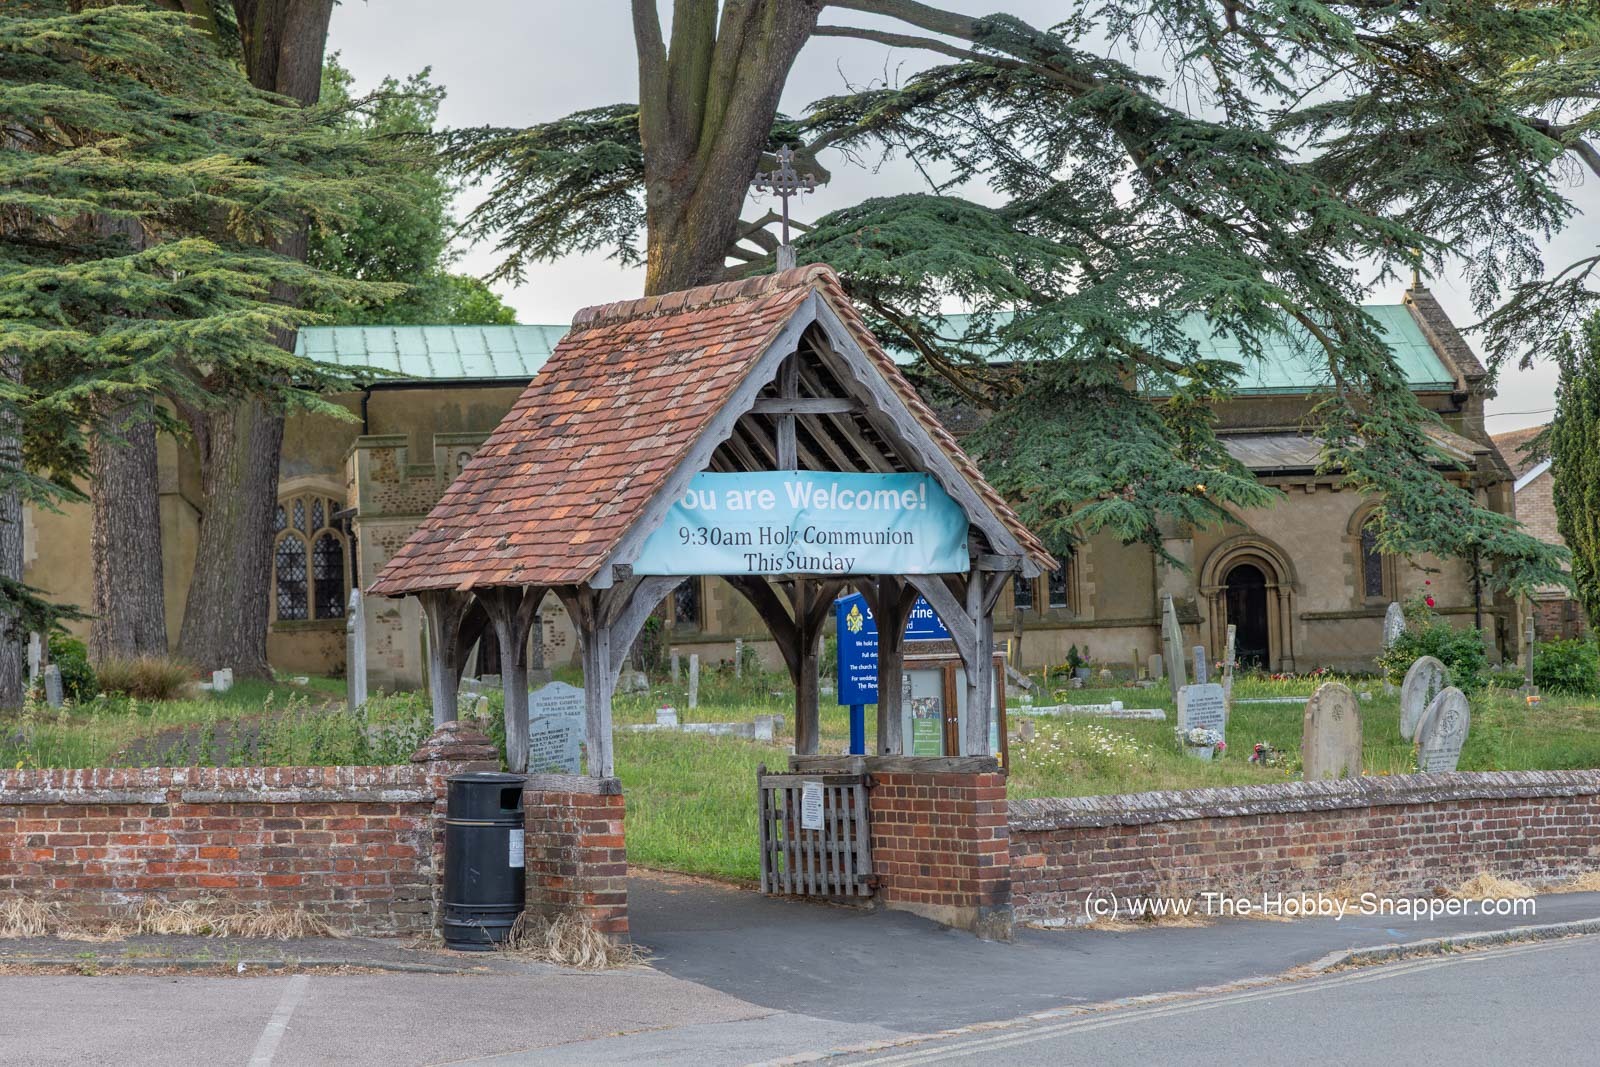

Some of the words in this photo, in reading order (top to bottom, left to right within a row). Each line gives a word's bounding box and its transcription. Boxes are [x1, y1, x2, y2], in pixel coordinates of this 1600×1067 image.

[680, 488, 716, 510] ou
[726, 488, 775, 511] are
[784, 481, 926, 510] Welcome!
[679, 527, 752, 546] 9:30am
[758, 526, 798, 549] Holy
[803, 526, 914, 545] Communion
[744, 553, 783, 572] This
[787, 551, 856, 574] Sunday
